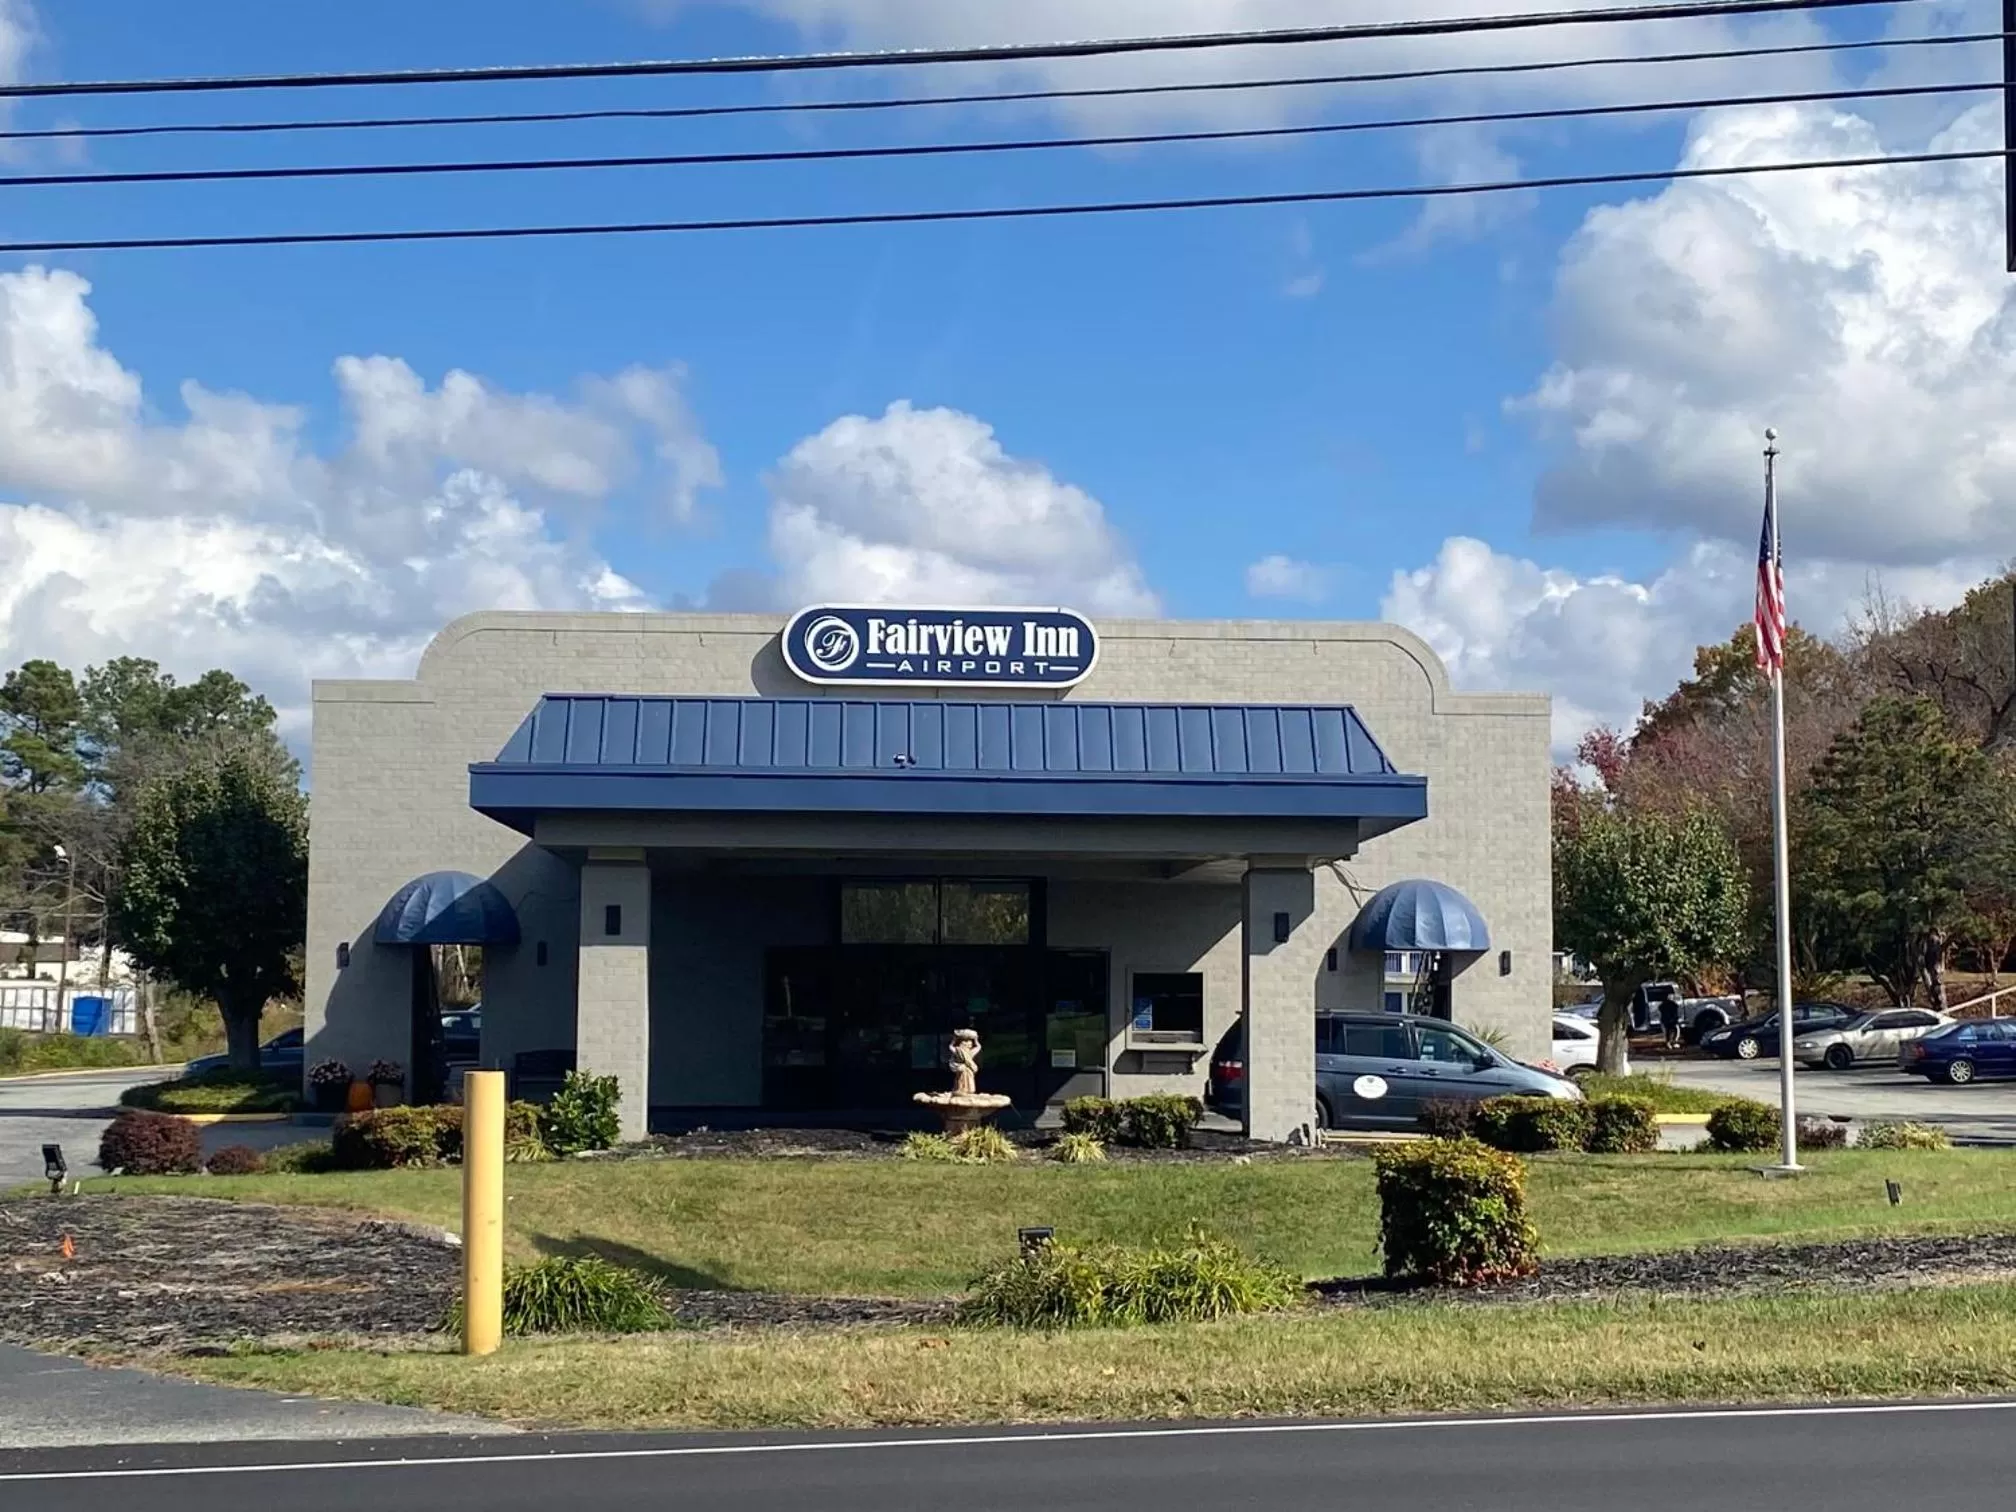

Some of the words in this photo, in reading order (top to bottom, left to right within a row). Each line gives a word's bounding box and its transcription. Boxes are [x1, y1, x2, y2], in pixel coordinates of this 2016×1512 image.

[866, 618, 1013, 657] Fairview
[1022, 621, 1079, 658] Inn
[897, 660, 1049, 675] AIRPORT
